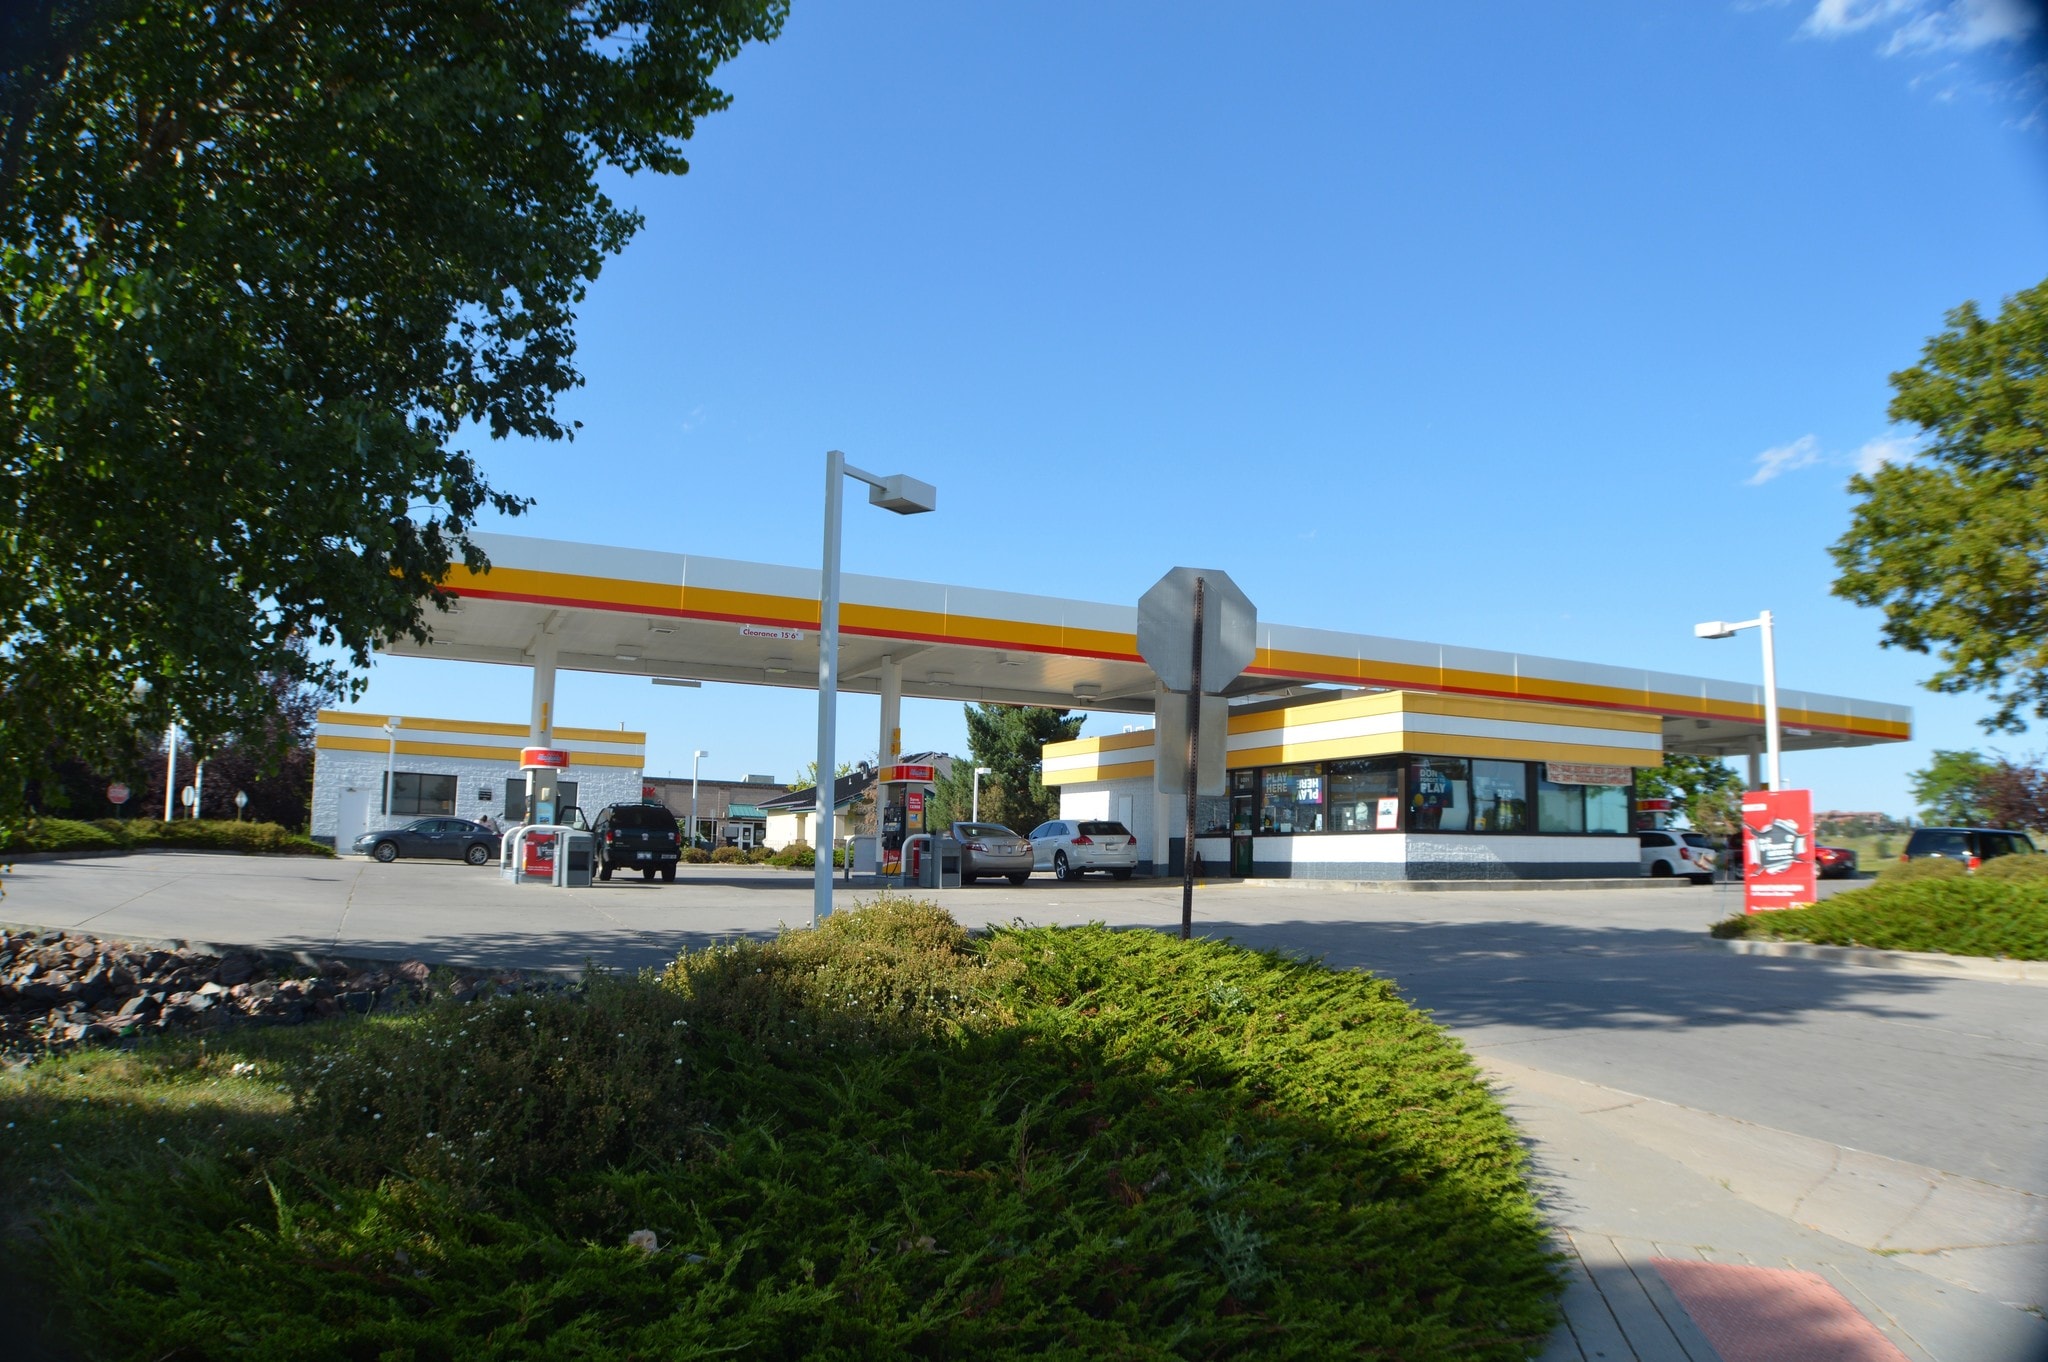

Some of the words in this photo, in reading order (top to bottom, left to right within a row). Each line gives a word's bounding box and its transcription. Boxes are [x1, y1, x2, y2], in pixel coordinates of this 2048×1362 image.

[743, 628, 778, 638] Clearance
[1266, 772, 1287, 783] PLAY
[1296, 777, 1319, 788] HERE
[1266, 783, 1287, 793] HERE
[1420, 783, 1446, 793] PLAY
[1297, 788, 1319, 800] PLAY
